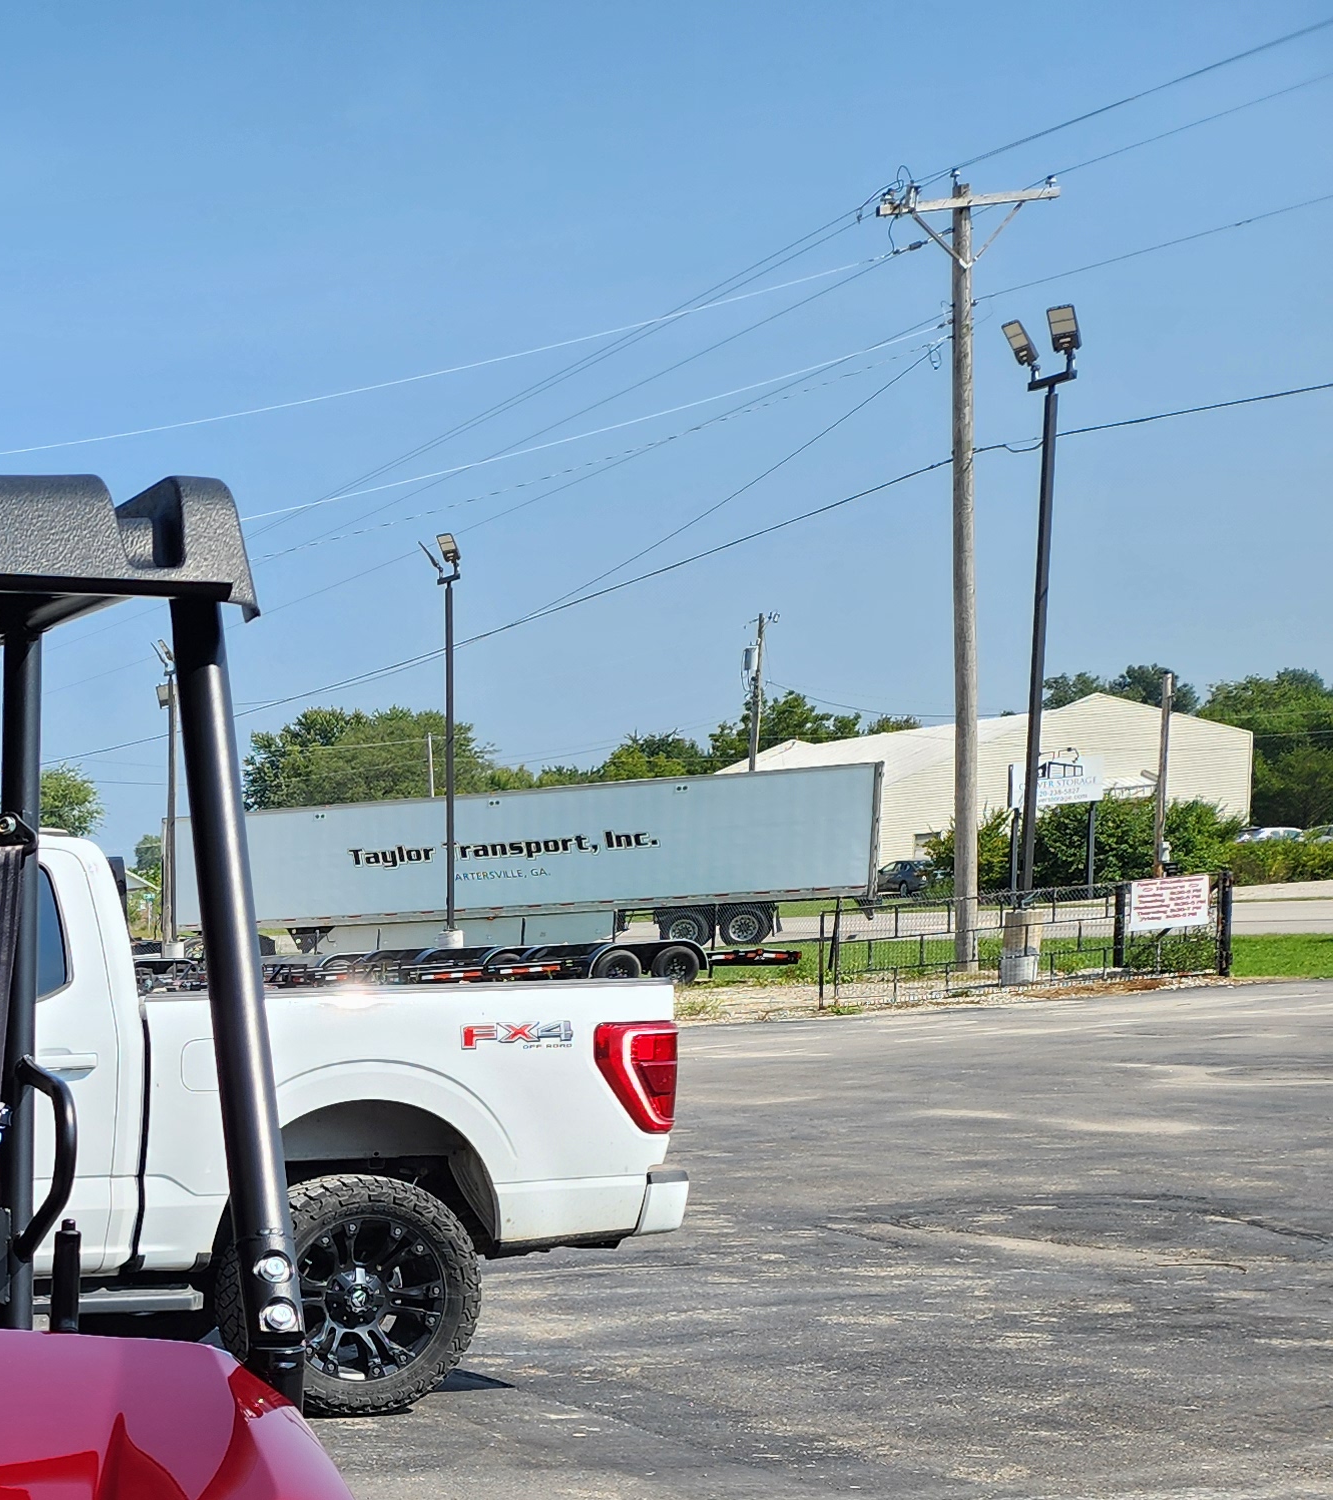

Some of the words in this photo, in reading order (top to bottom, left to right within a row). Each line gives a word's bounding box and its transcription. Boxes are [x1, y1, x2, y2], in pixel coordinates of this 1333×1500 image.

[1018, 780, 1054, 791] CVER
[1056, 776, 1097, 787] STORAGE
[1038, 787, 1080, 797] 20-238-5827
[348, 845, 436, 869] Taylor
[604, 830, 660, 849] Inc.
[453, 868, 527, 882] ARTERSVILLE,
[530, 867, 552, 877] GA.
[460, 1020, 574, 1050] FX4
